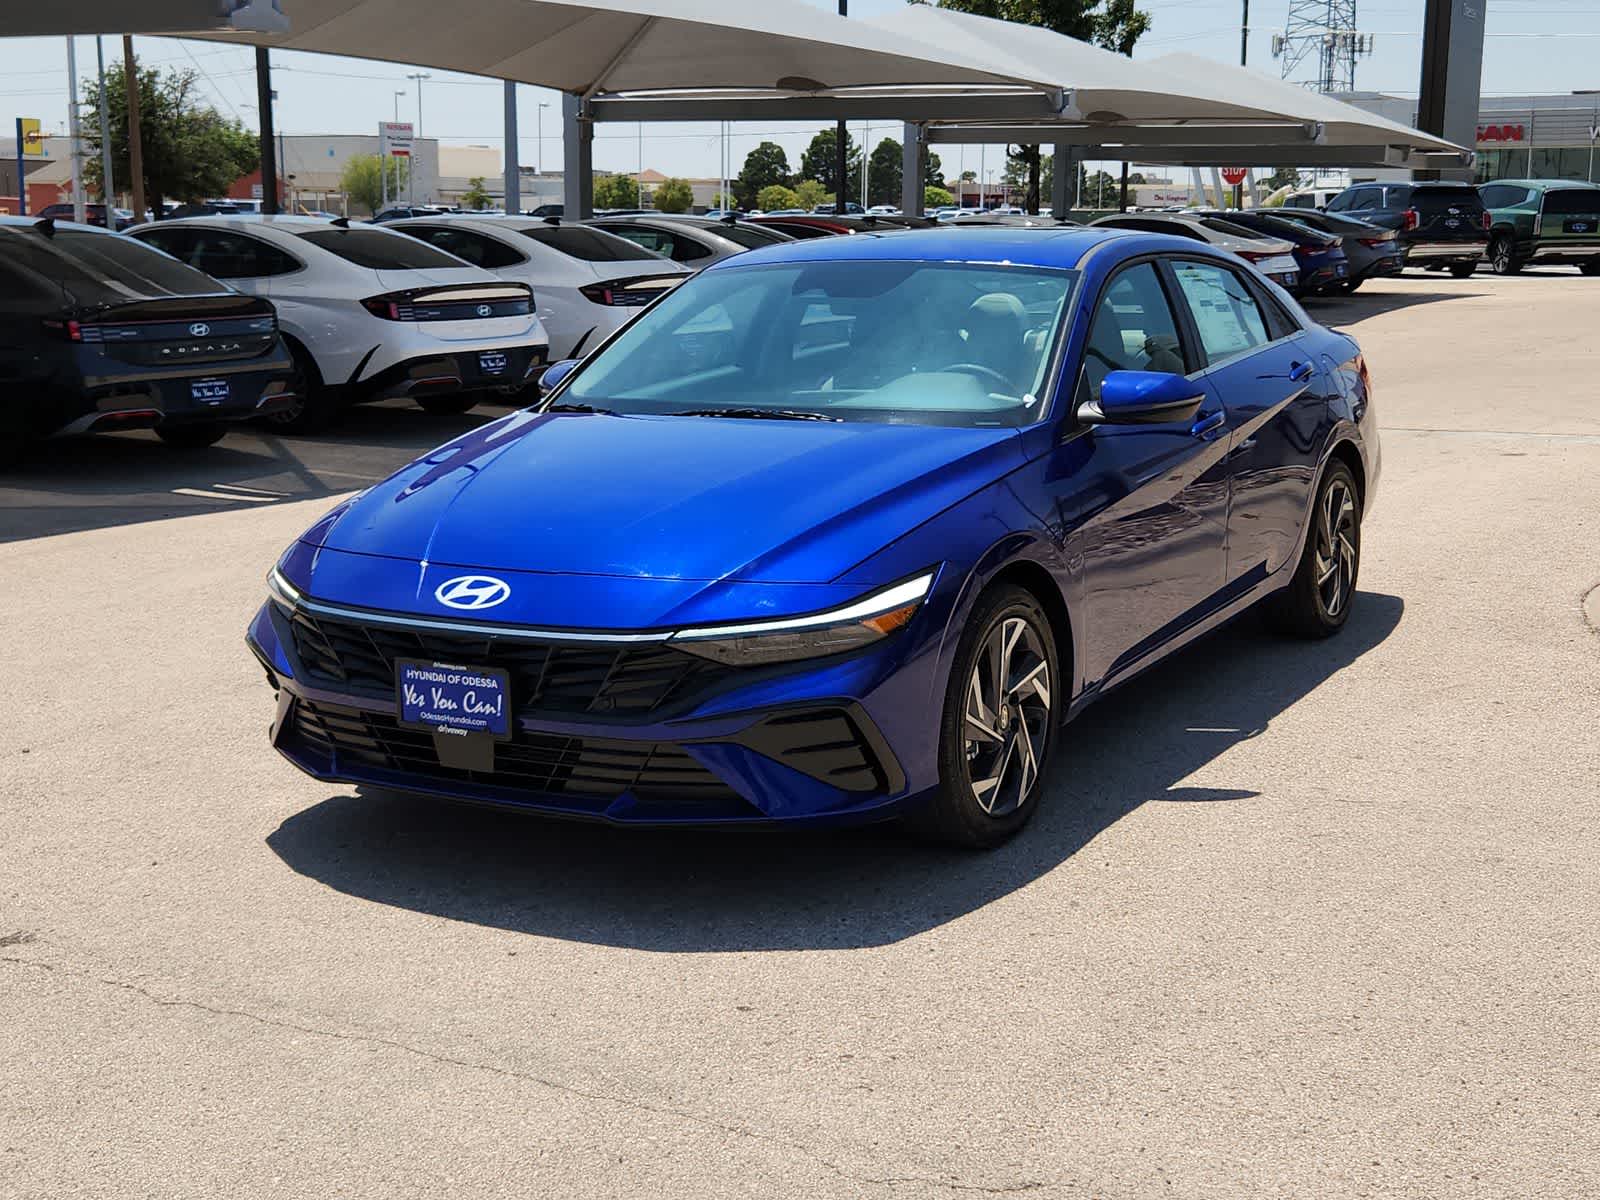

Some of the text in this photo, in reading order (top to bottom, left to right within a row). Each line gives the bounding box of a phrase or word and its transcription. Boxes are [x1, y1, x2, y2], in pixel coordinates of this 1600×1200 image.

[1223, 167, 1244, 176] STOP
[162, 343, 240, 353] SONATA
[407, 669, 498, 689] HYUNDAI OF ODESSA
[403, 683, 502, 717] Yes You Can!
[420, 711, 488, 727] OdessaHyundai.com
[437, 724, 469, 737] driveway
